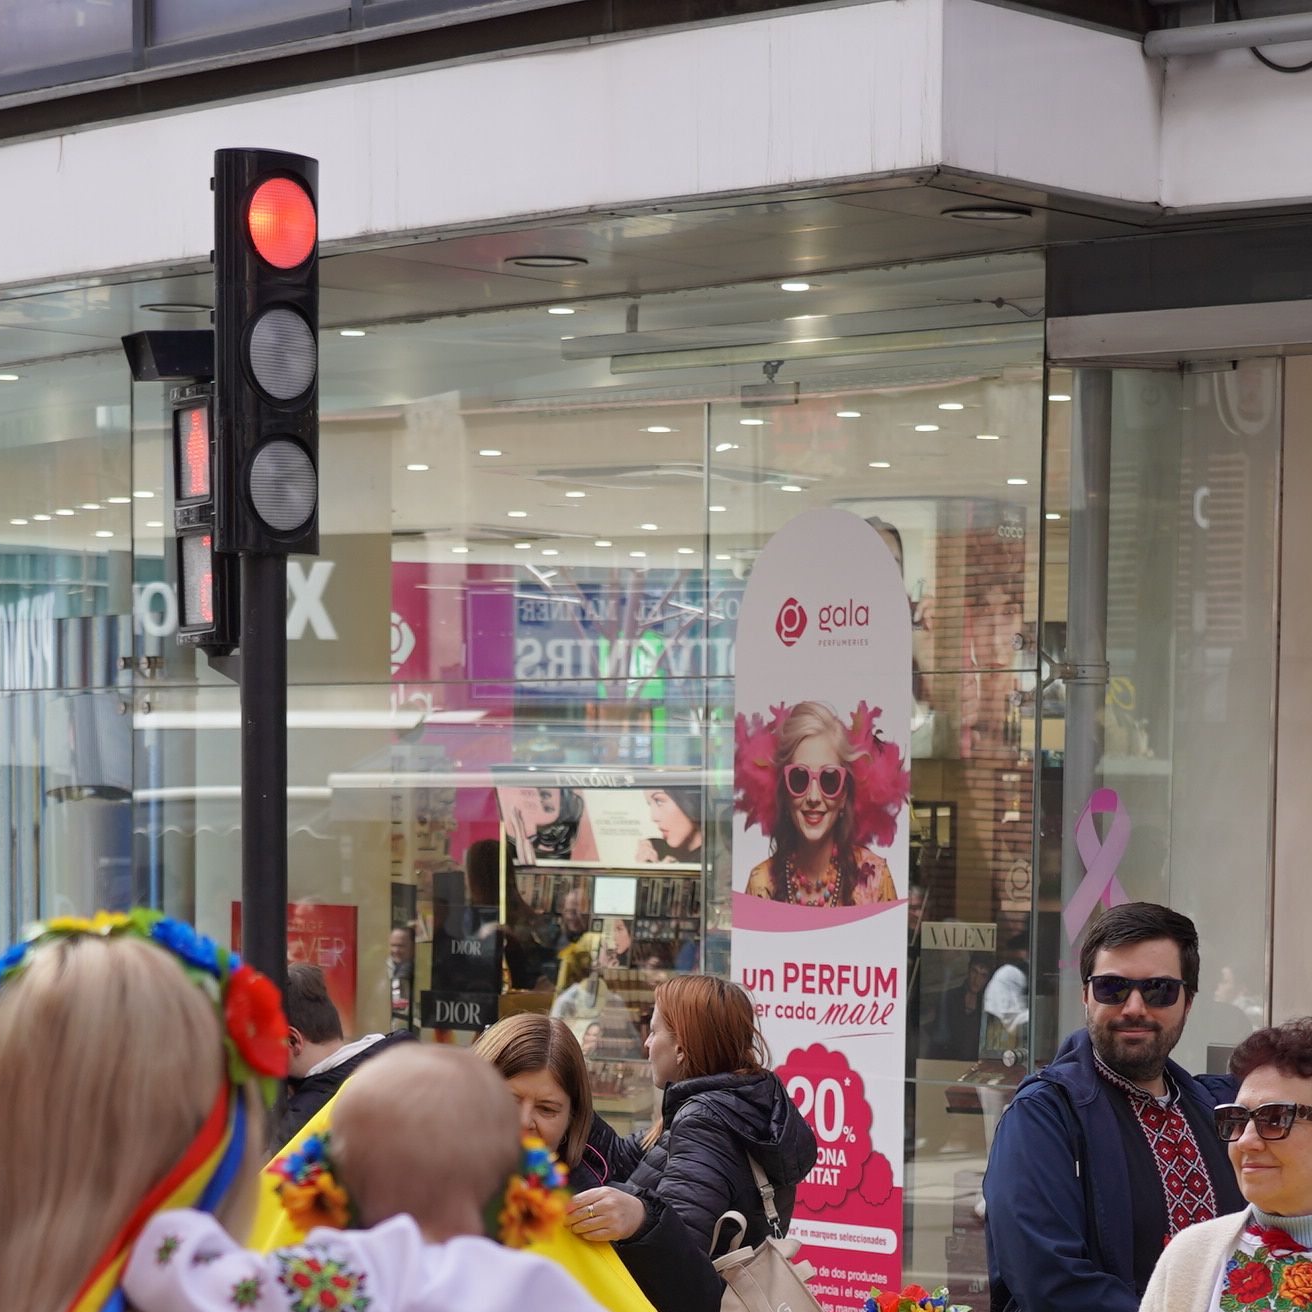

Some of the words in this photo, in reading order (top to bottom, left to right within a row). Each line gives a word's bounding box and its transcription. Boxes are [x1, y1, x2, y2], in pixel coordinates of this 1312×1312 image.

[818, 599, 869, 633] gala
[818, 639, 869, 647] PERFUMERIES
[450, 939, 483, 956] DIOR
[742, 967, 774, 993] un
[783, 962, 898, 999] PERFUM
[435, 1000, 481, 1026] DIOR
[754, 1003, 770, 1018] er
[775, 1001, 816, 1020] cada
[816, 1001, 895, 1026] mare
[800, 1229, 808, 1237] en
[810, 1230, 838, 1242] marques
[819, 1266, 830, 1278] de
[831, 1267, 846, 1280] dos
[848, 1271, 888, 1285] productes
[845, 1287, 853, 1299] el
[822, 1301, 834, 1312] les
